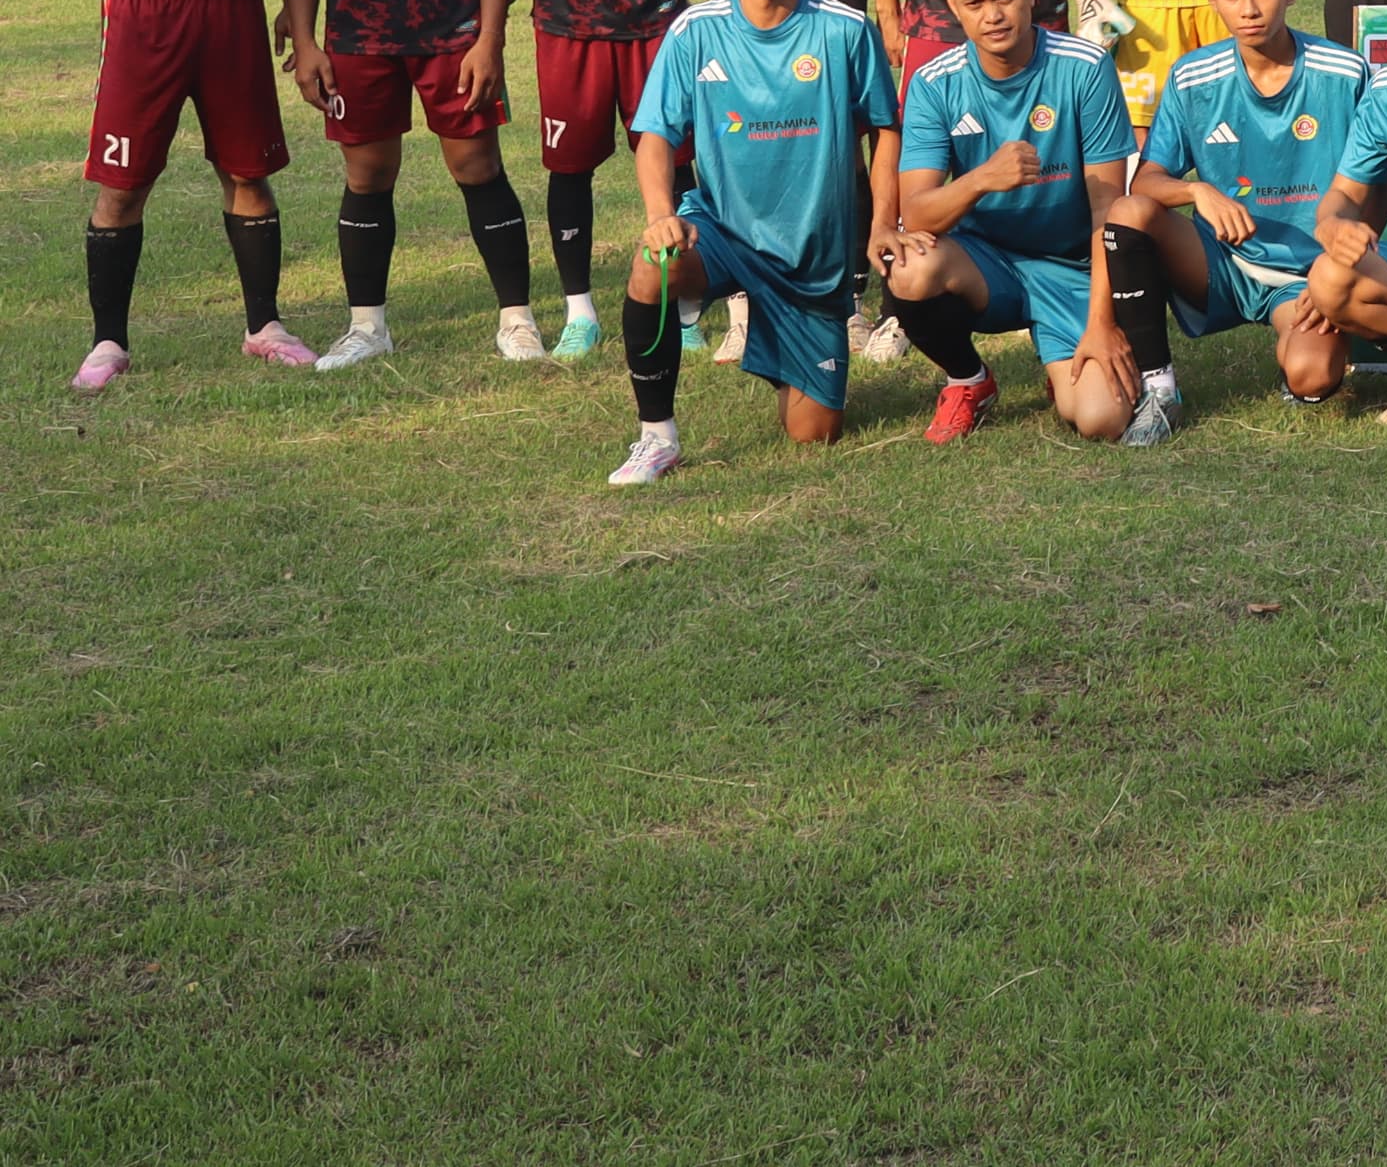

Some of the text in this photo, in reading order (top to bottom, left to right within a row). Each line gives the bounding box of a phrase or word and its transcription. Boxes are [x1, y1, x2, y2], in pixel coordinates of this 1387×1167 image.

[545, 118, 568, 149] 17
[748, 116, 818, 131] PERTAMINA
[103, 134, 130, 169] 21
[1256, 182, 1319, 198] PERTAMINA
